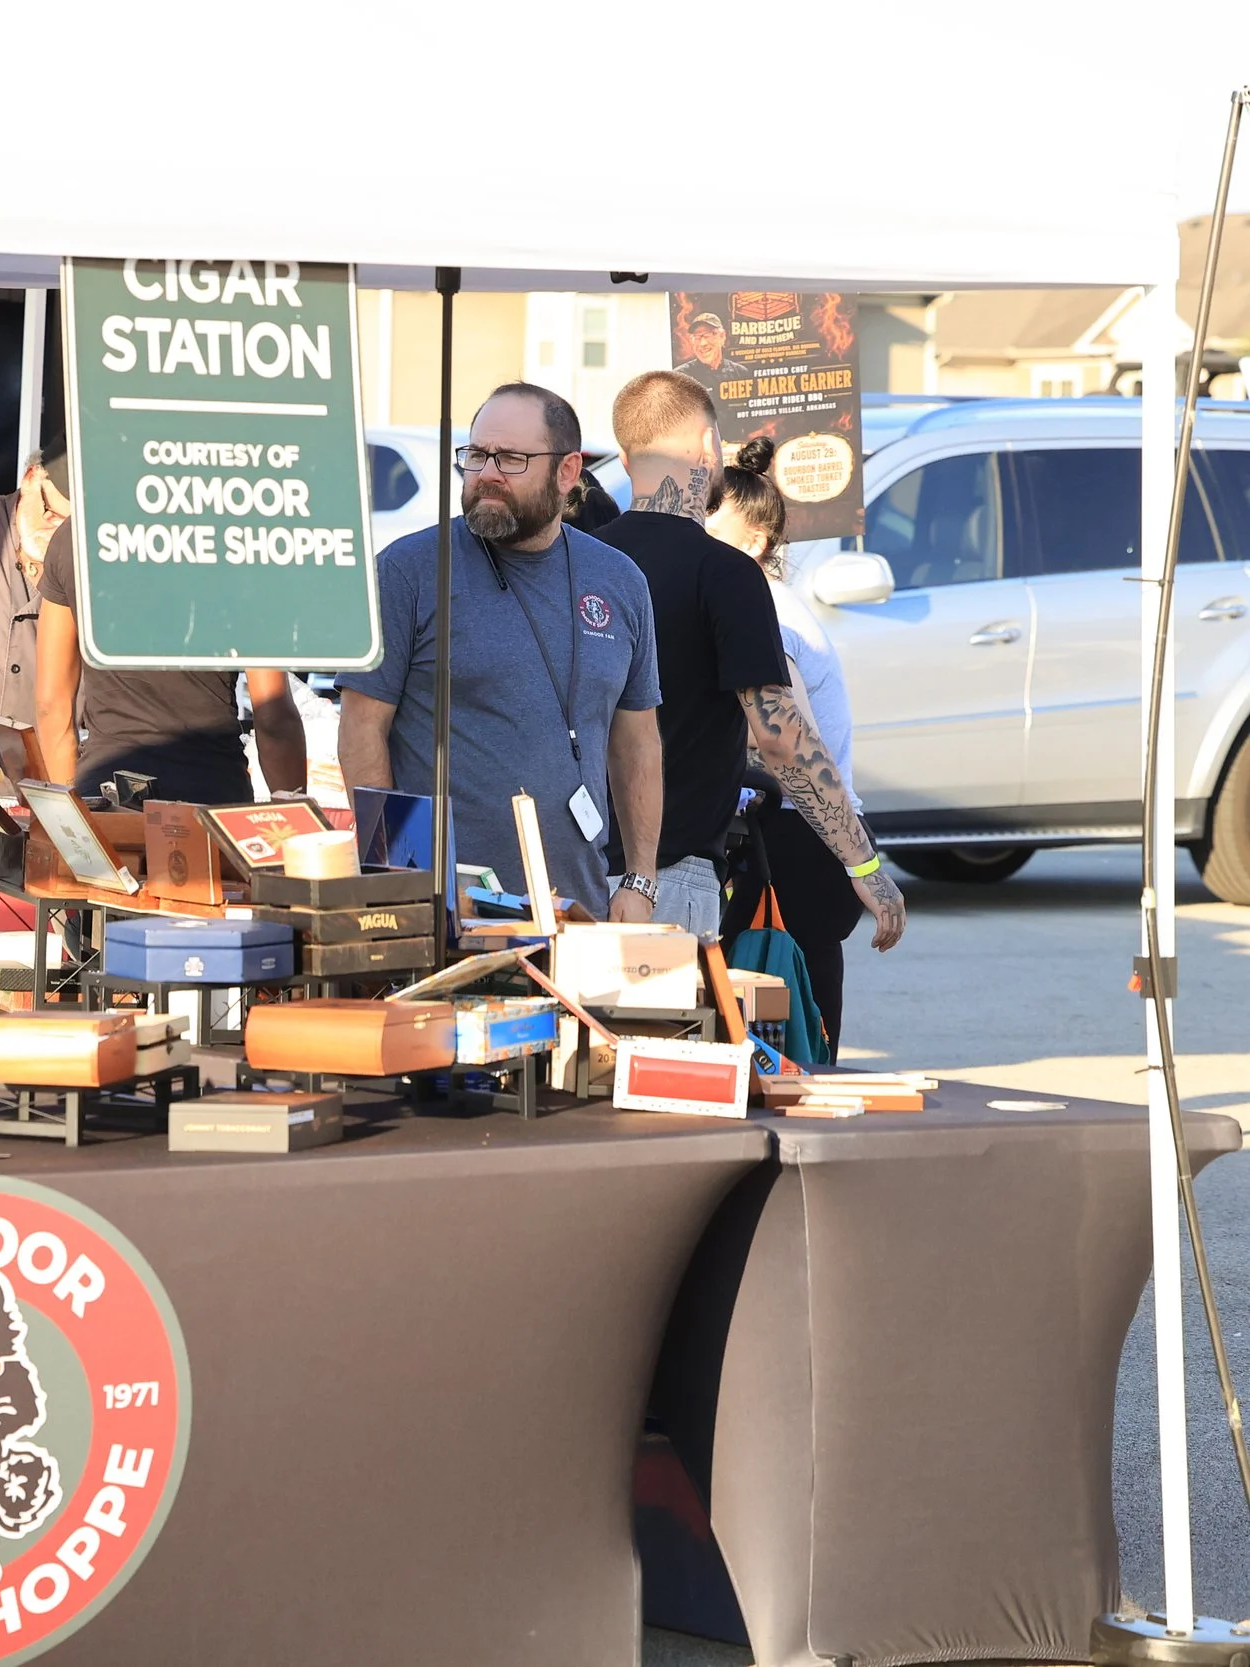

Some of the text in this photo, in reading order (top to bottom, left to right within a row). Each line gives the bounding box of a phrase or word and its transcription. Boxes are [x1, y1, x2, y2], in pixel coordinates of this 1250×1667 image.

[123, 259, 303, 307] CIGAR
[731, 316, 801, 335] BARBECUE
[739, 331, 795, 345] AND MAYHEM
[101, 315, 332, 380] STATION
[754, 365, 808, 377] FEATURED CHEF
[719, 369, 852, 400] CHEF MARK GARNER
[748, 393, 823, 408] CIRCUIT RIDER BBQ
[751, 408, 777, 417] SPRINGS
[143, 440, 300, 468] COURTESY OF
[791, 449, 821, 461] AUGUST
[135, 474, 310, 517] OXMOOR
[97, 523, 356, 566] SMOKE SHOPPE
[246, 810, 287, 824] YAGUA
[358, 913, 398, 931] YAGUA
[598, 1053, 610, 1064] 20
[102, 1381, 159, 1410] 1971
